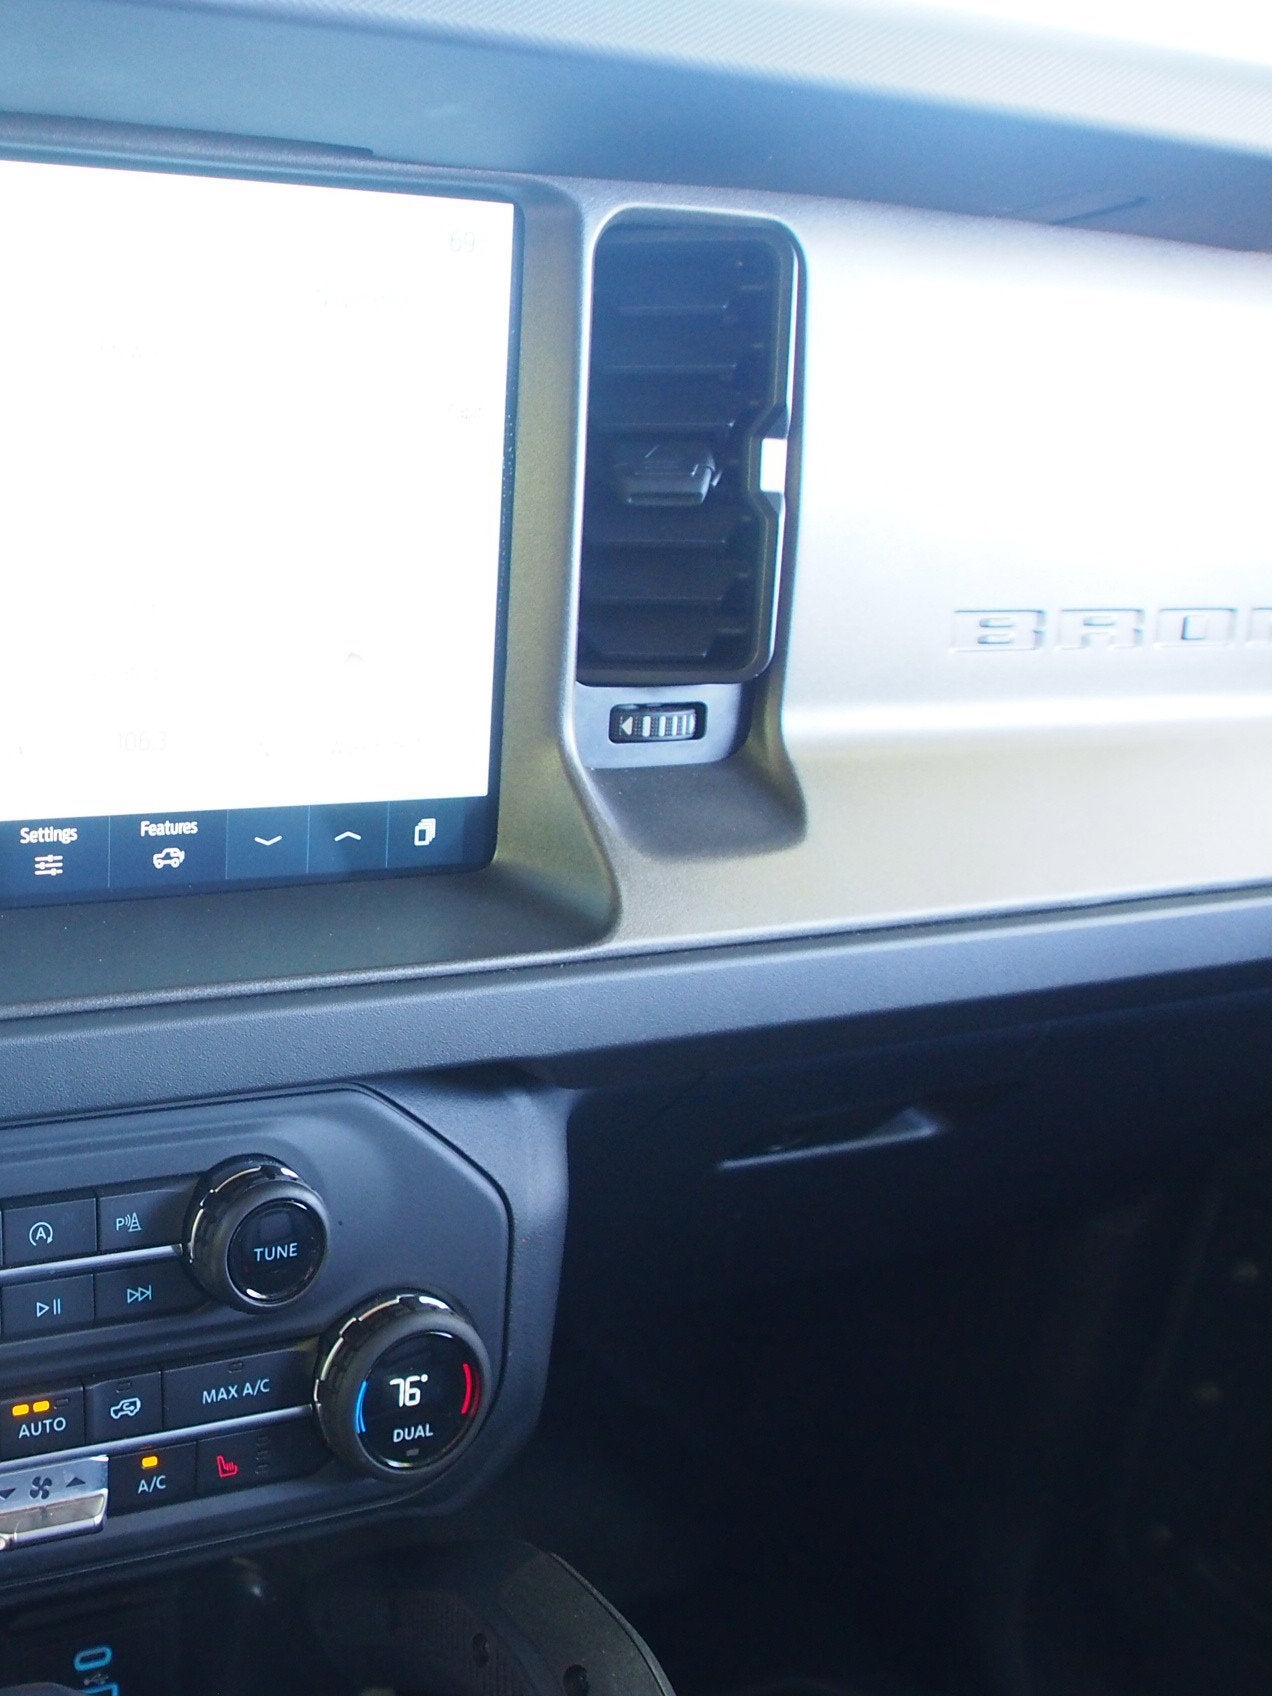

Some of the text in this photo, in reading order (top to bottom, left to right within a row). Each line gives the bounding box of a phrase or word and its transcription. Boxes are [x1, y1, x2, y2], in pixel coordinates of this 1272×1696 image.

[19, 825, 78, 845] Settings
[140, 820, 199, 838] Features
[253, 1242, 298, 1262] TUNE
[202, 1377, 271, 1405] MAX A/C
[389, 1373, 429, 1408] 76°
[17, 1416, 68, 1440] AUTO
[392, 1422, 435, 1443] DUAL
[137, 1474, 168, 1495] A/C
